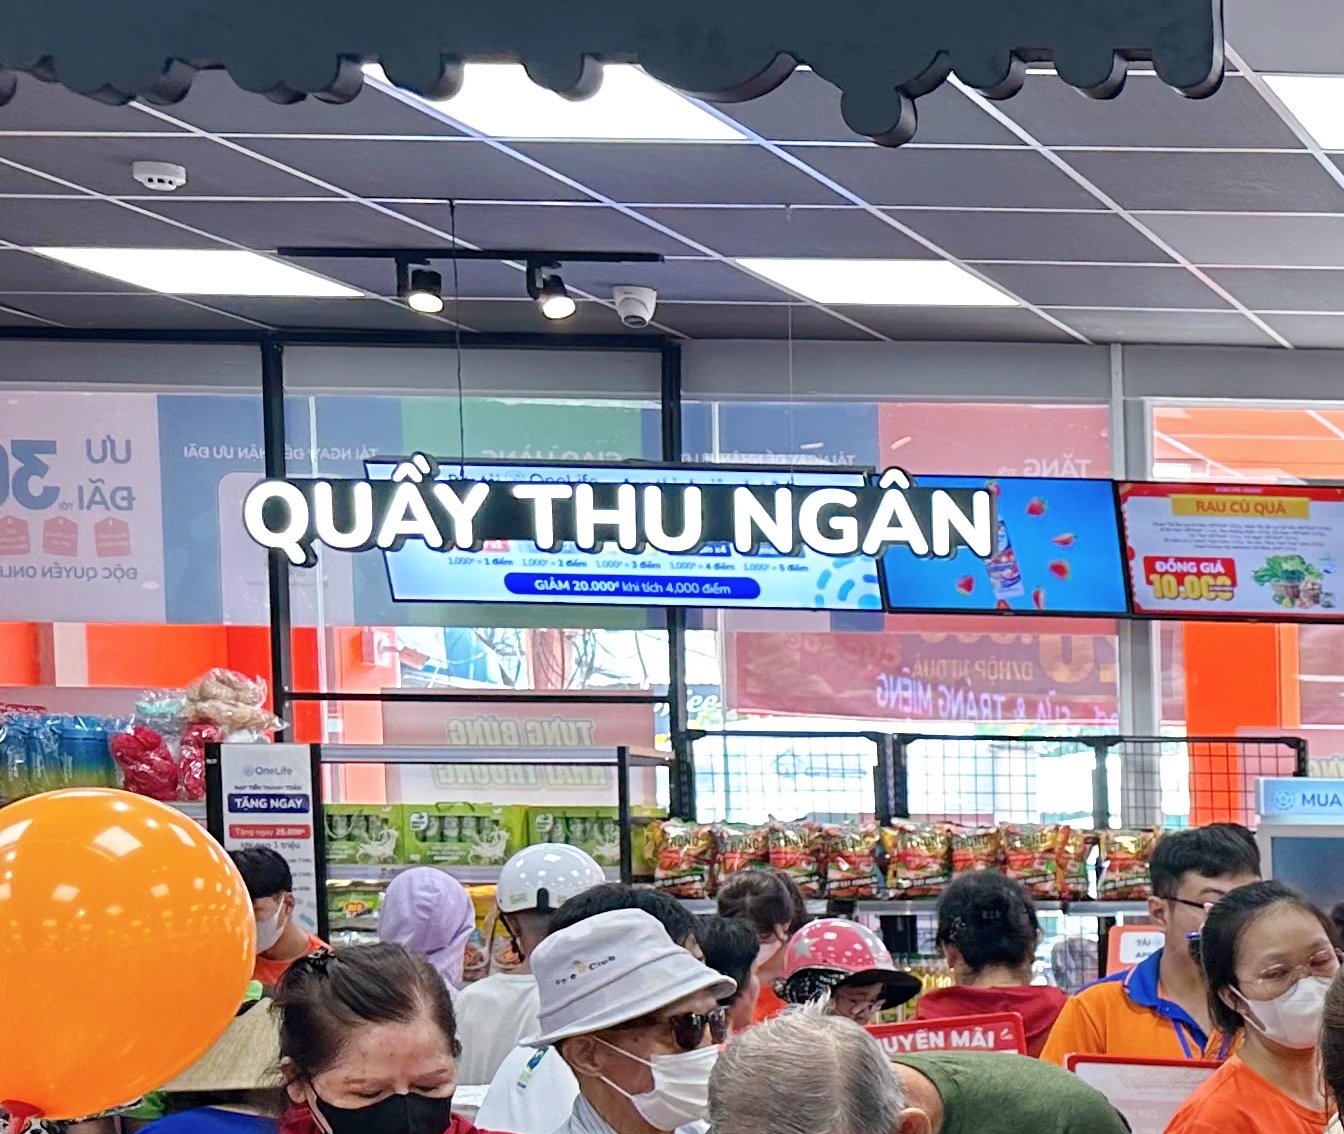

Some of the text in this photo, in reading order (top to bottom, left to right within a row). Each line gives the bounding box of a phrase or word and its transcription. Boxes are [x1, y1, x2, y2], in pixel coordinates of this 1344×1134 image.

[245, 454, 992, 562] QUẦY THU NGÂN
[1196, 499, 1286, 515] RAU CỦ QUẢ
[235, 796, 302, 811] TẶNG NGAY
[1302, 794, 1342, 808] MUA
[951, 1026, 995, 1048] MÃI
